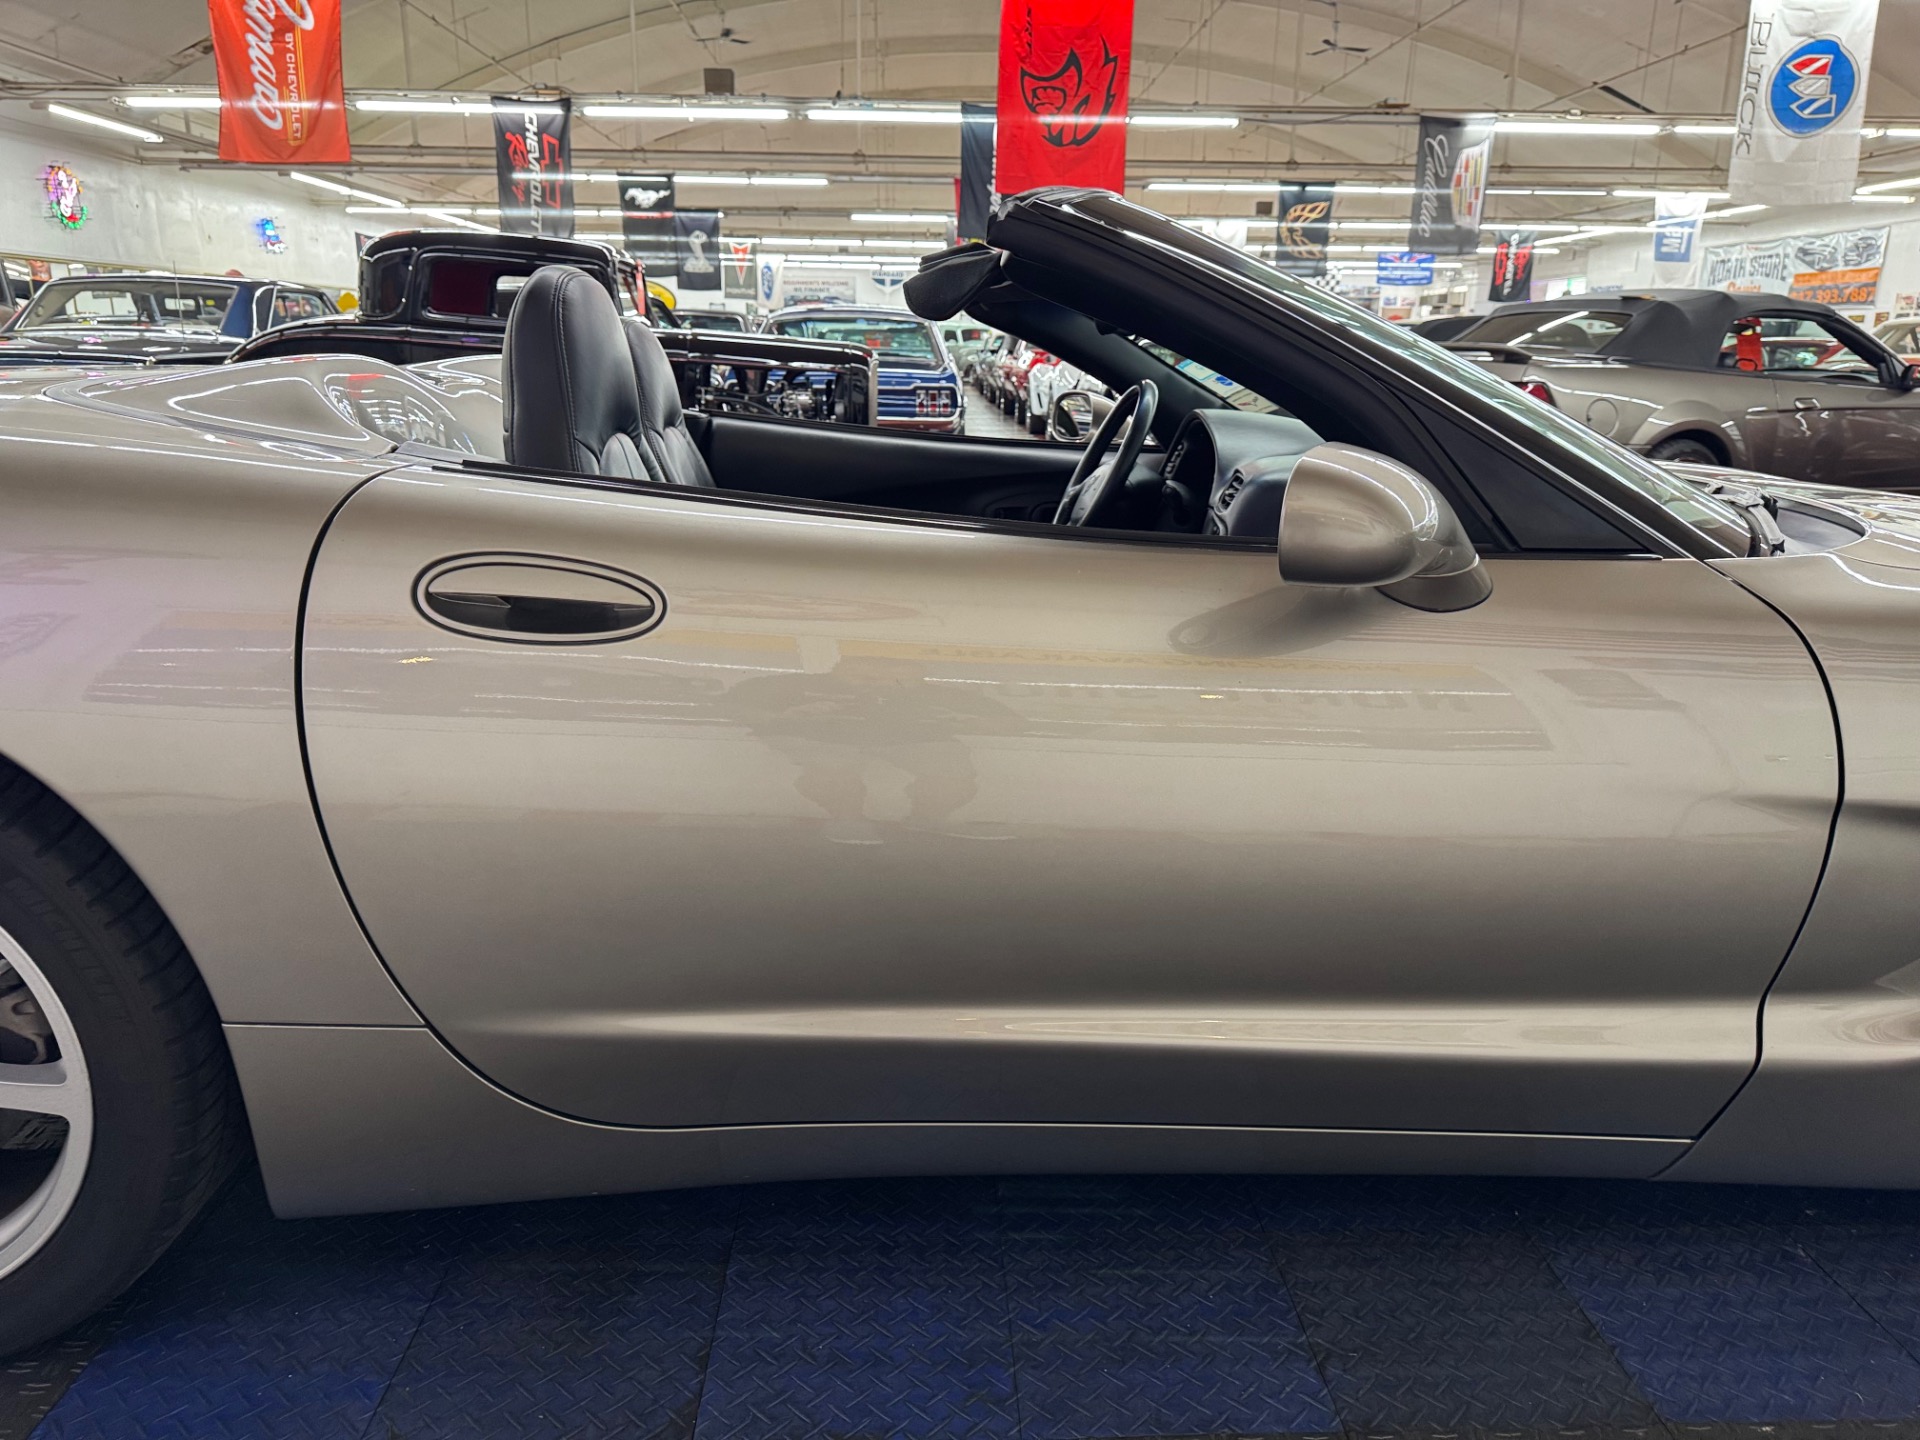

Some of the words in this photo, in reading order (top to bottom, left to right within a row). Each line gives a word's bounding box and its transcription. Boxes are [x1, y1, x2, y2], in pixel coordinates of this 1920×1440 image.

[284, 32, 295, 49] BY
[285, 54, 302, 138] CHEVROLET
[1735, 12, 1774, 156] BUICK
[505, 131, 529, 206] Racng
[1418, 134, 1449, 238] Cadillac
[1706, 256, 1746, 287] NORTH
[1750, 253, 1790, 282] SHORE
